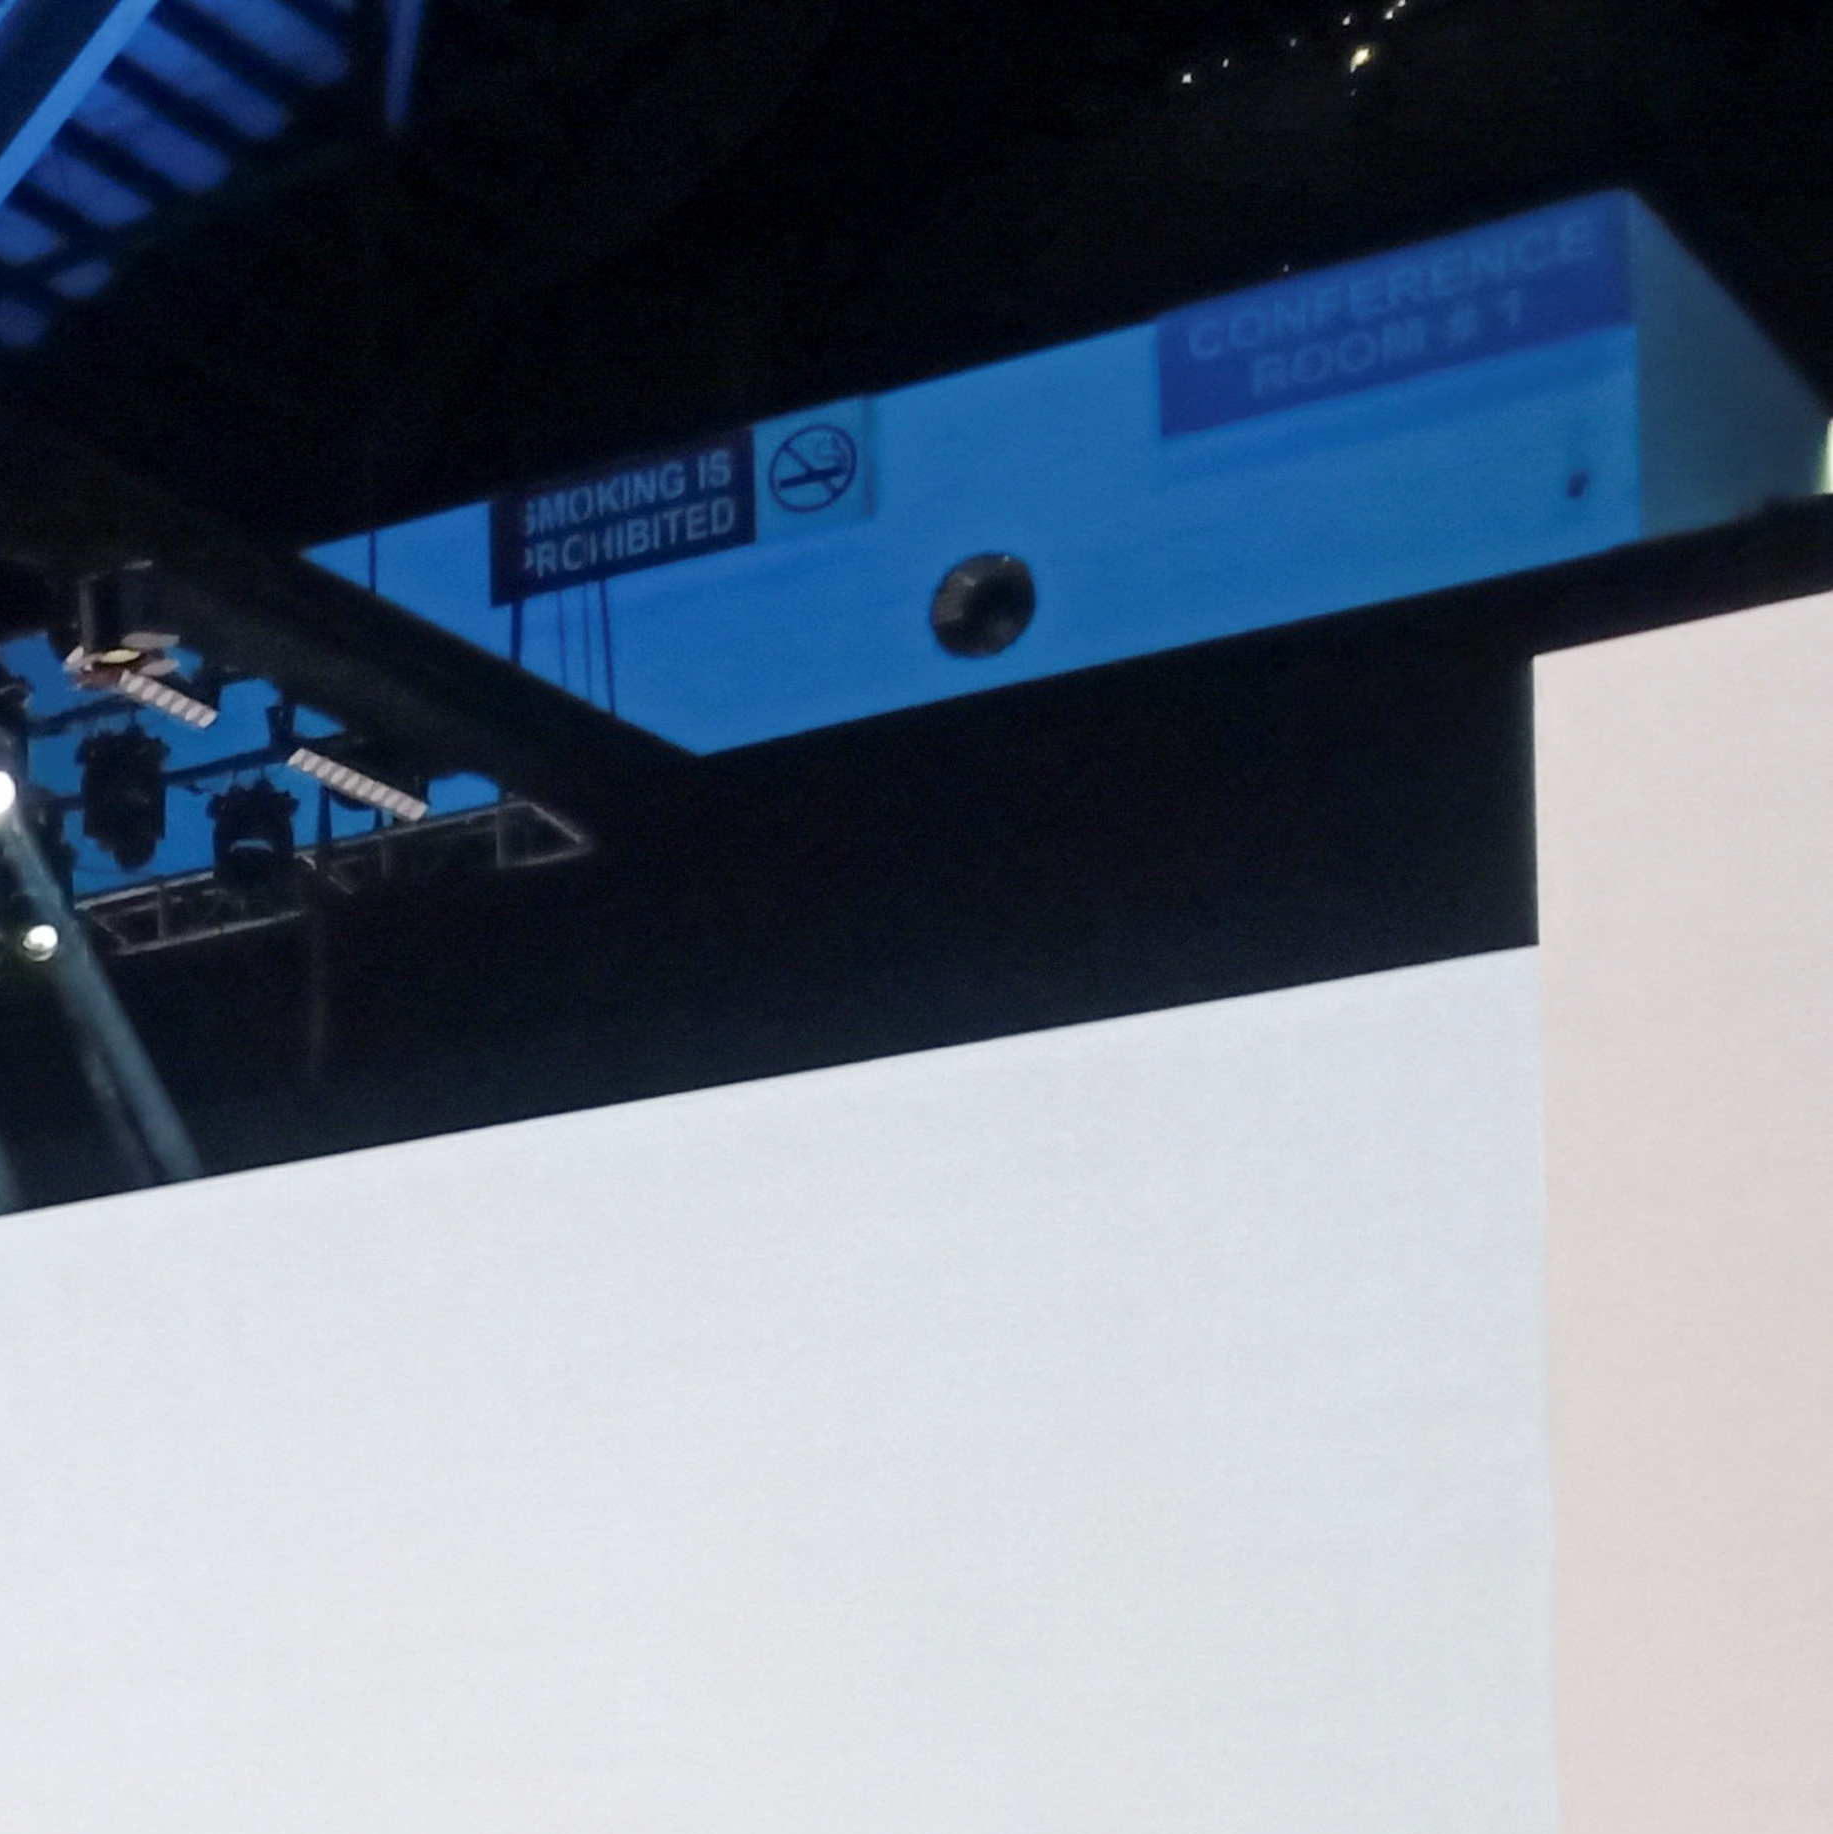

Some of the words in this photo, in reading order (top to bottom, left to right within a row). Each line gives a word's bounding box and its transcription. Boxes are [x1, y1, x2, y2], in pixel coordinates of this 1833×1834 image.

[1187, 216, 1595, 360] CONFERENCE
[1249, 315, 1428, 399] ROOM
[698, 449, 733, 491] IS
